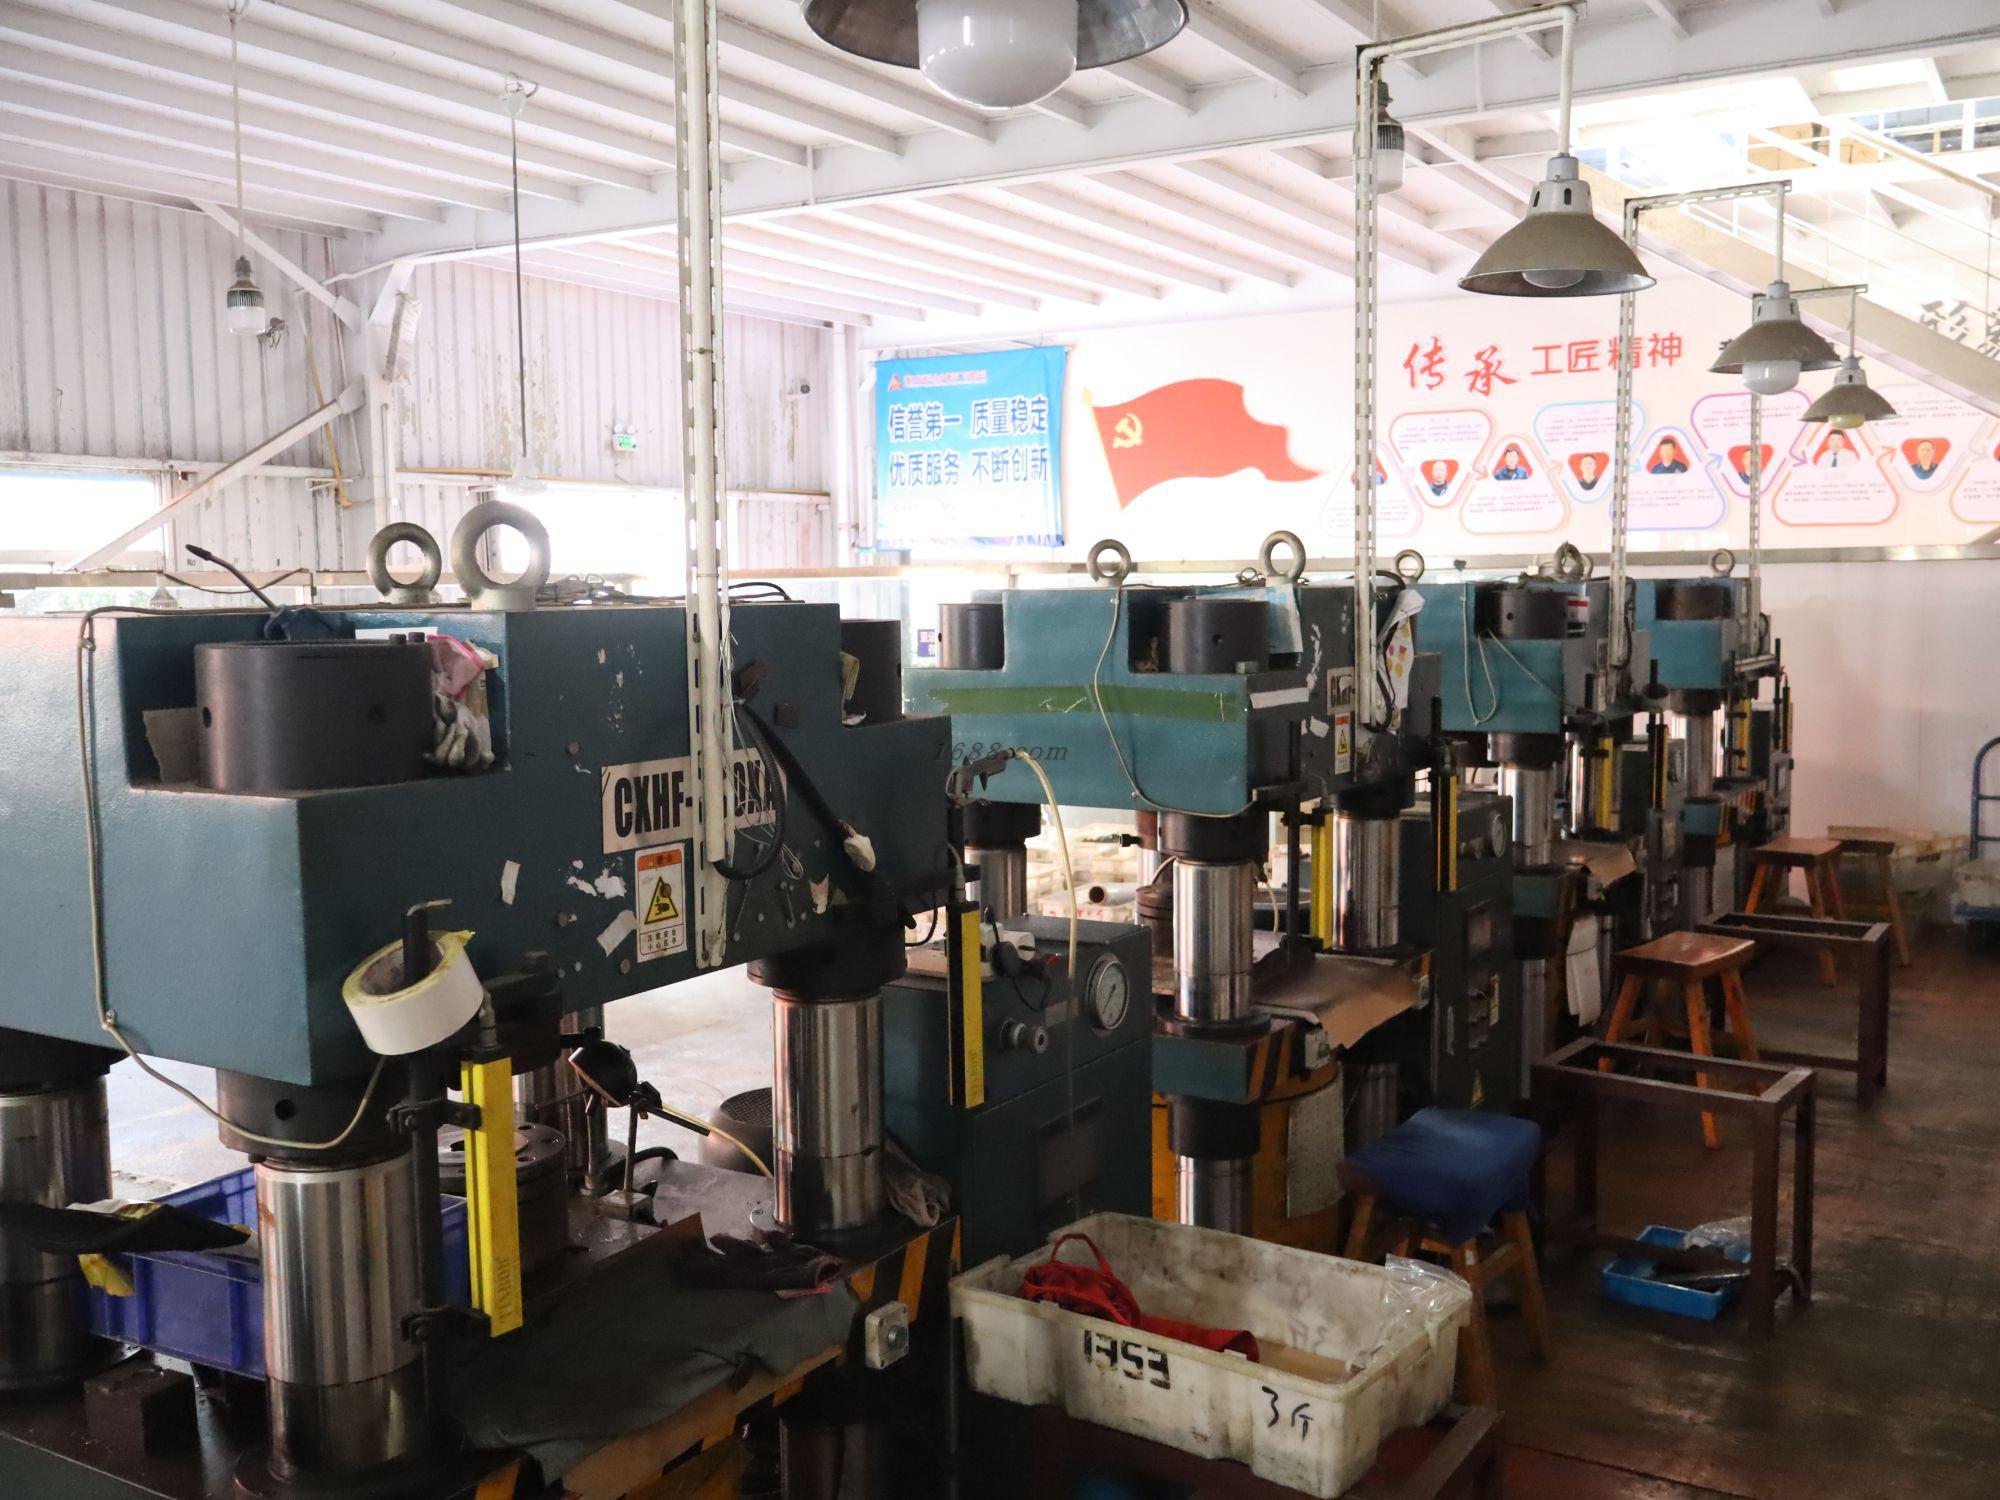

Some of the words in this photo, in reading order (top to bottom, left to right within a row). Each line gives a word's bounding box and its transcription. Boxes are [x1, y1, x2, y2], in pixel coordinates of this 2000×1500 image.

[1403, 335, 1518, 397] 传承
[1531, 332, 1683, 375] 工匠精神
[889, 404, 961, 441] 信誉第一
[972, 396, 1049, 437] 质量稳定
[890, 452, 960, 488] 优质服务
[972, 447, 1048, 484] 不断创新
